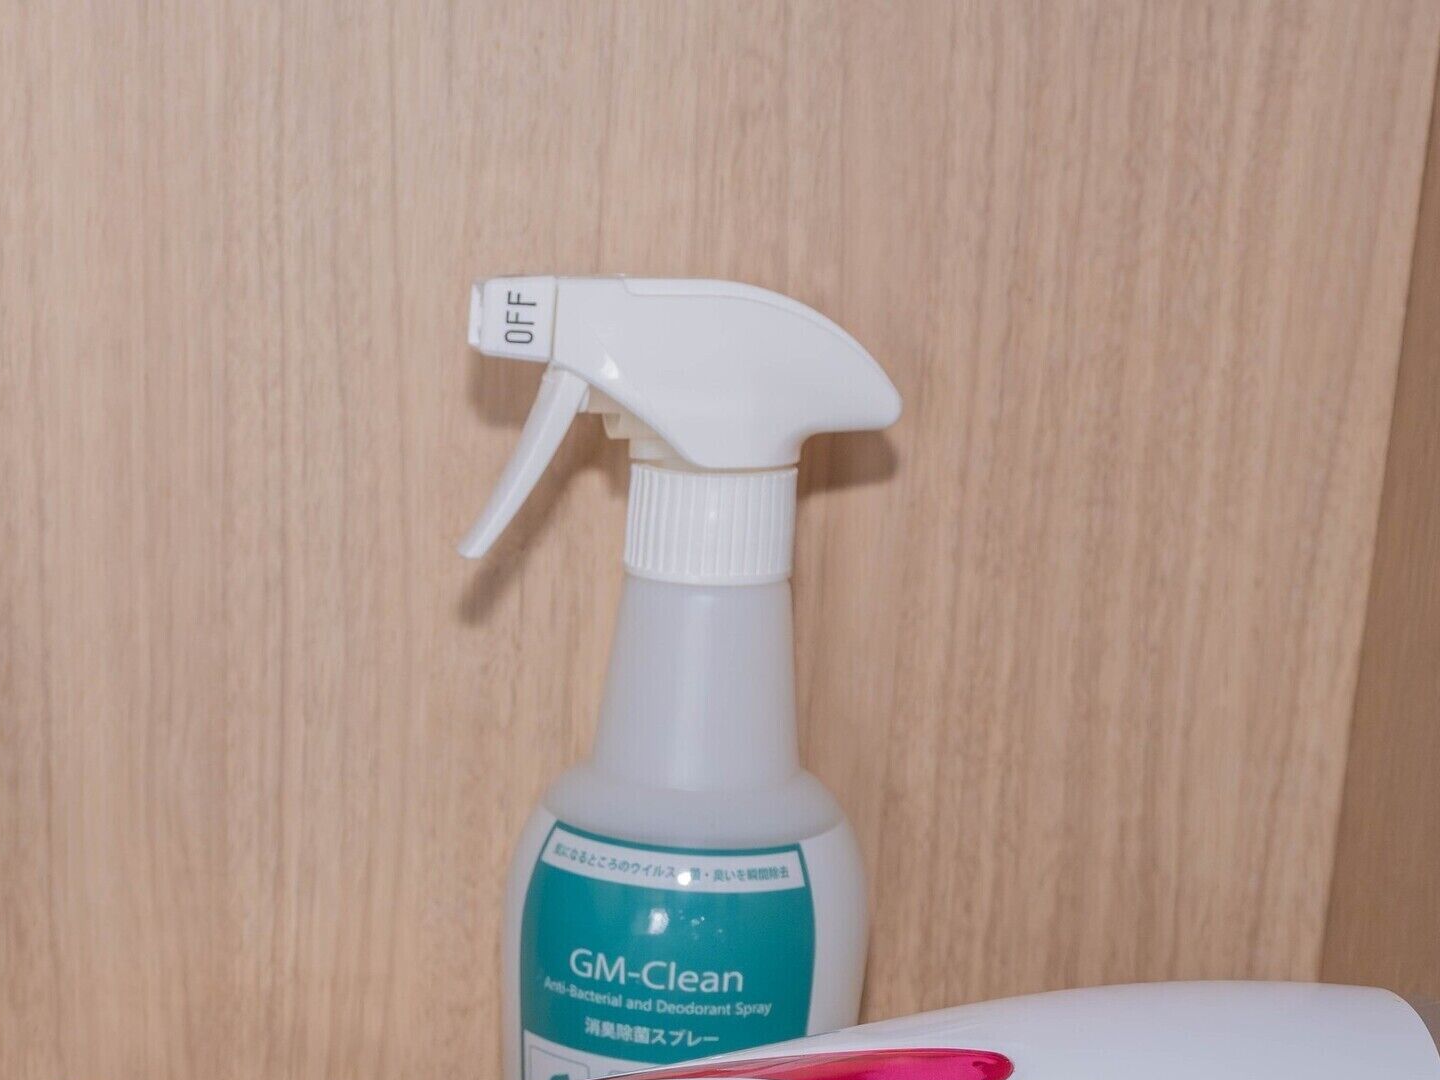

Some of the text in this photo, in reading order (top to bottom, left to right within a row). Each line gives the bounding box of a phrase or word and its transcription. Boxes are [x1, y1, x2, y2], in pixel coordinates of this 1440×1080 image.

[505, 291, 537, 344] OFF
[569, 948, 744, 993] GM-Clean
[544, 975, 772, 1018] Anti-Bacterial and Deodorant Spray
[585, 1016, 720, 1047] 消臭除菌スプレー
